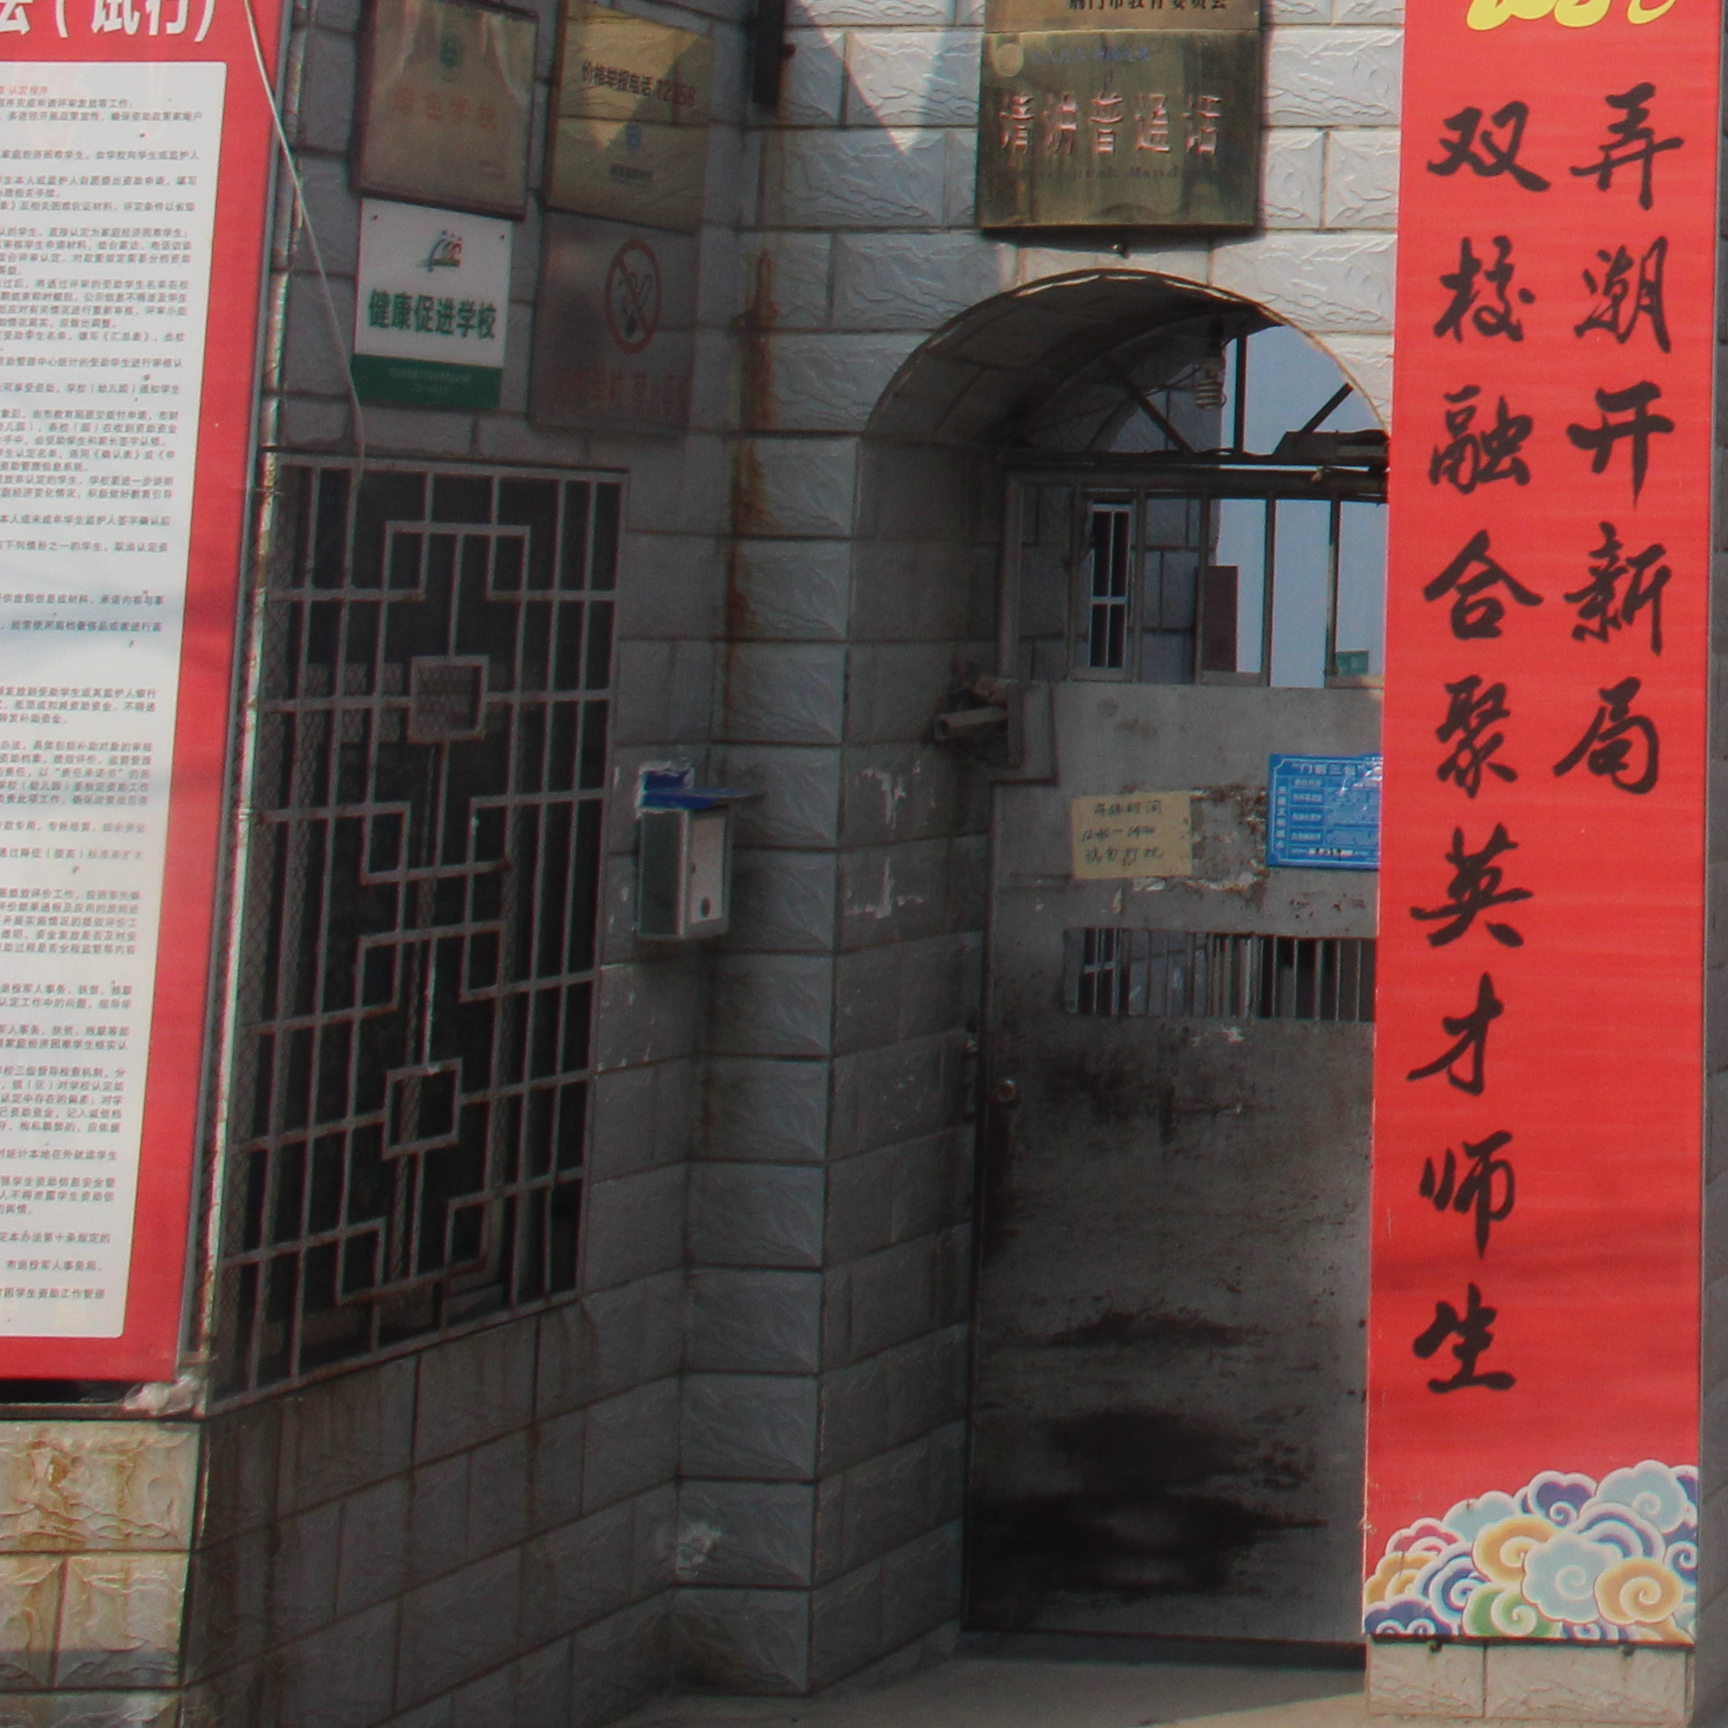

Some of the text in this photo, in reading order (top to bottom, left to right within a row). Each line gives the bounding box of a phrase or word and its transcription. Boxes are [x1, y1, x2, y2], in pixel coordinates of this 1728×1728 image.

[368, 288, 497, 341] 健康促进学校
[999, 92, 1223, 156] 请讲普通话
[1555, 82, 1685, 796] 弄潮开新局
[1406, 101, 1552, 1394] 双校融合聚英才师生
